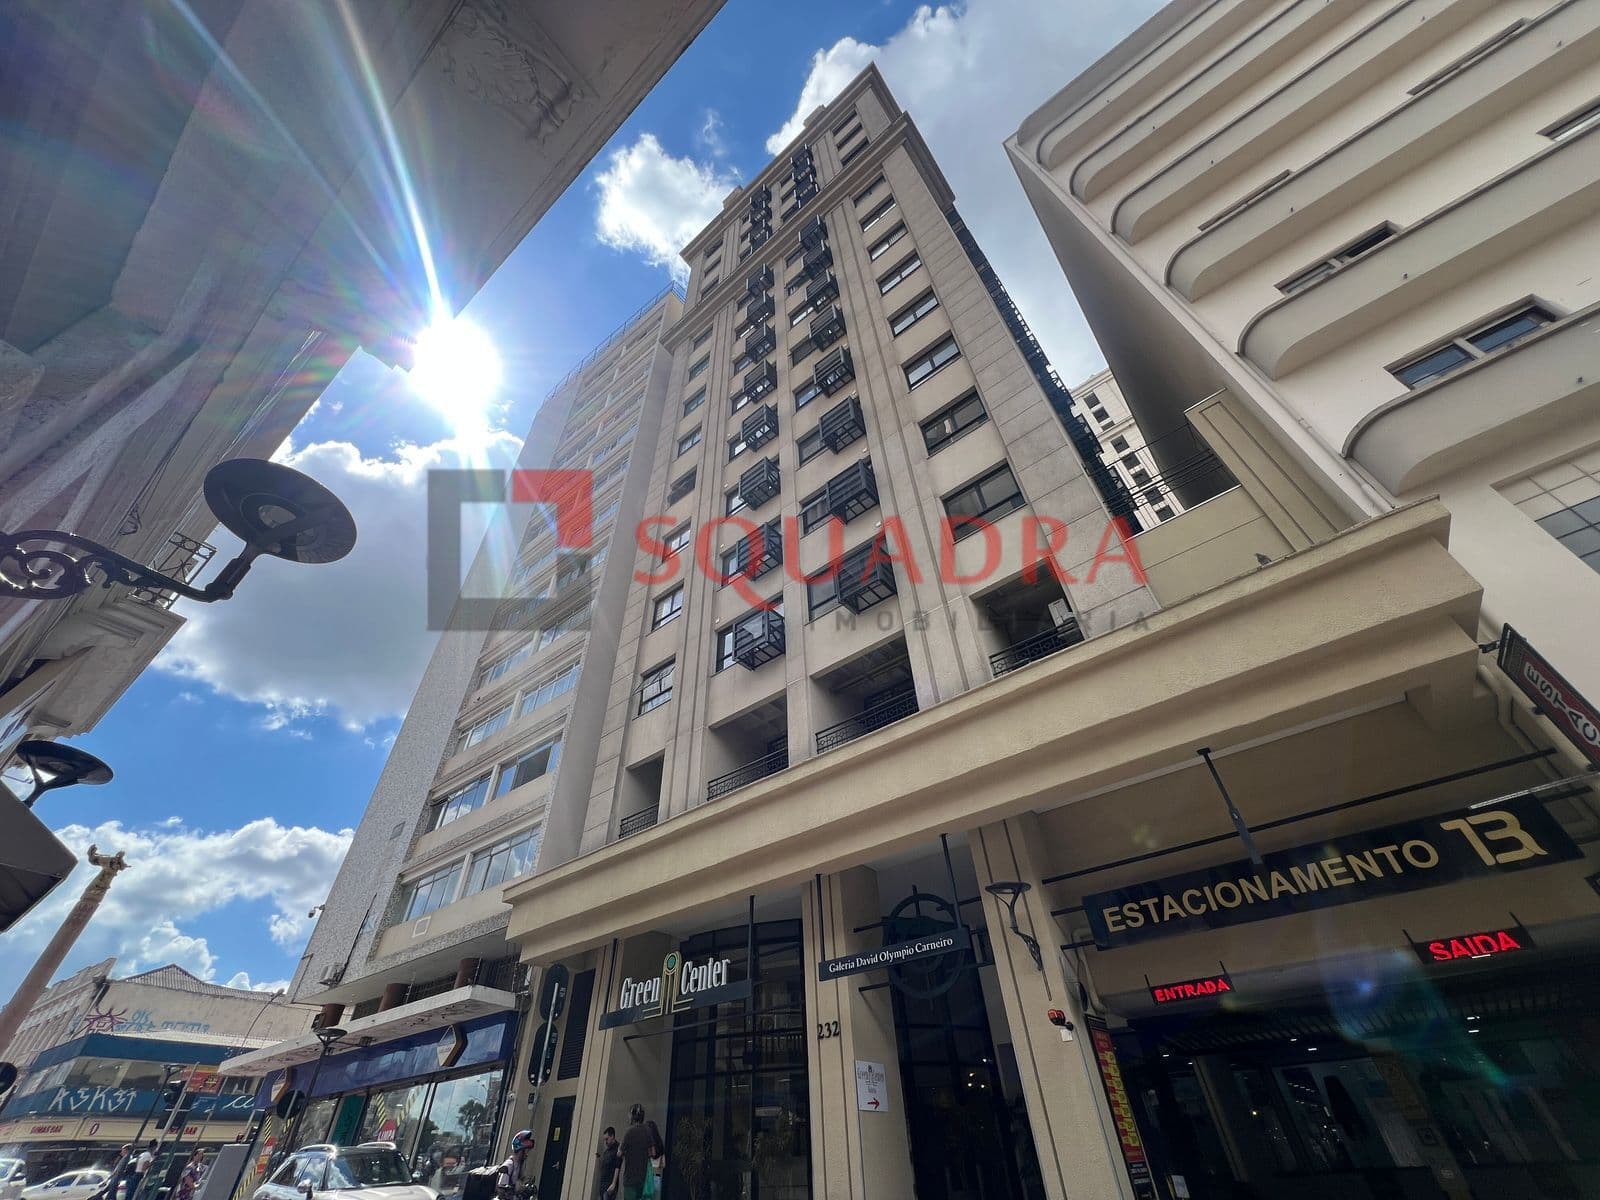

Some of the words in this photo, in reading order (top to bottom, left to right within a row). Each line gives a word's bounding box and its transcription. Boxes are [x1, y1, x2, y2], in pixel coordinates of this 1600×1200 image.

[1525, 663, 1600, 748] ESTAC
[1103, 839, 1439, 932] ESTACIONAMENTO
[829, 959, 855, 973] Galeria
[856, 953, 879, 968] David
[879, 945, 915, 963] Olympio
[915, 937, 953, 953] Carneiro
[1429, 930, 1520, 961] SAIDA
[620, 977, 660, 1010] Green
[681, 957, 730, 995] Center
[1154, 978, 1232, 1002] ENTRADA
[816, 1020, 841, 1040] 232
